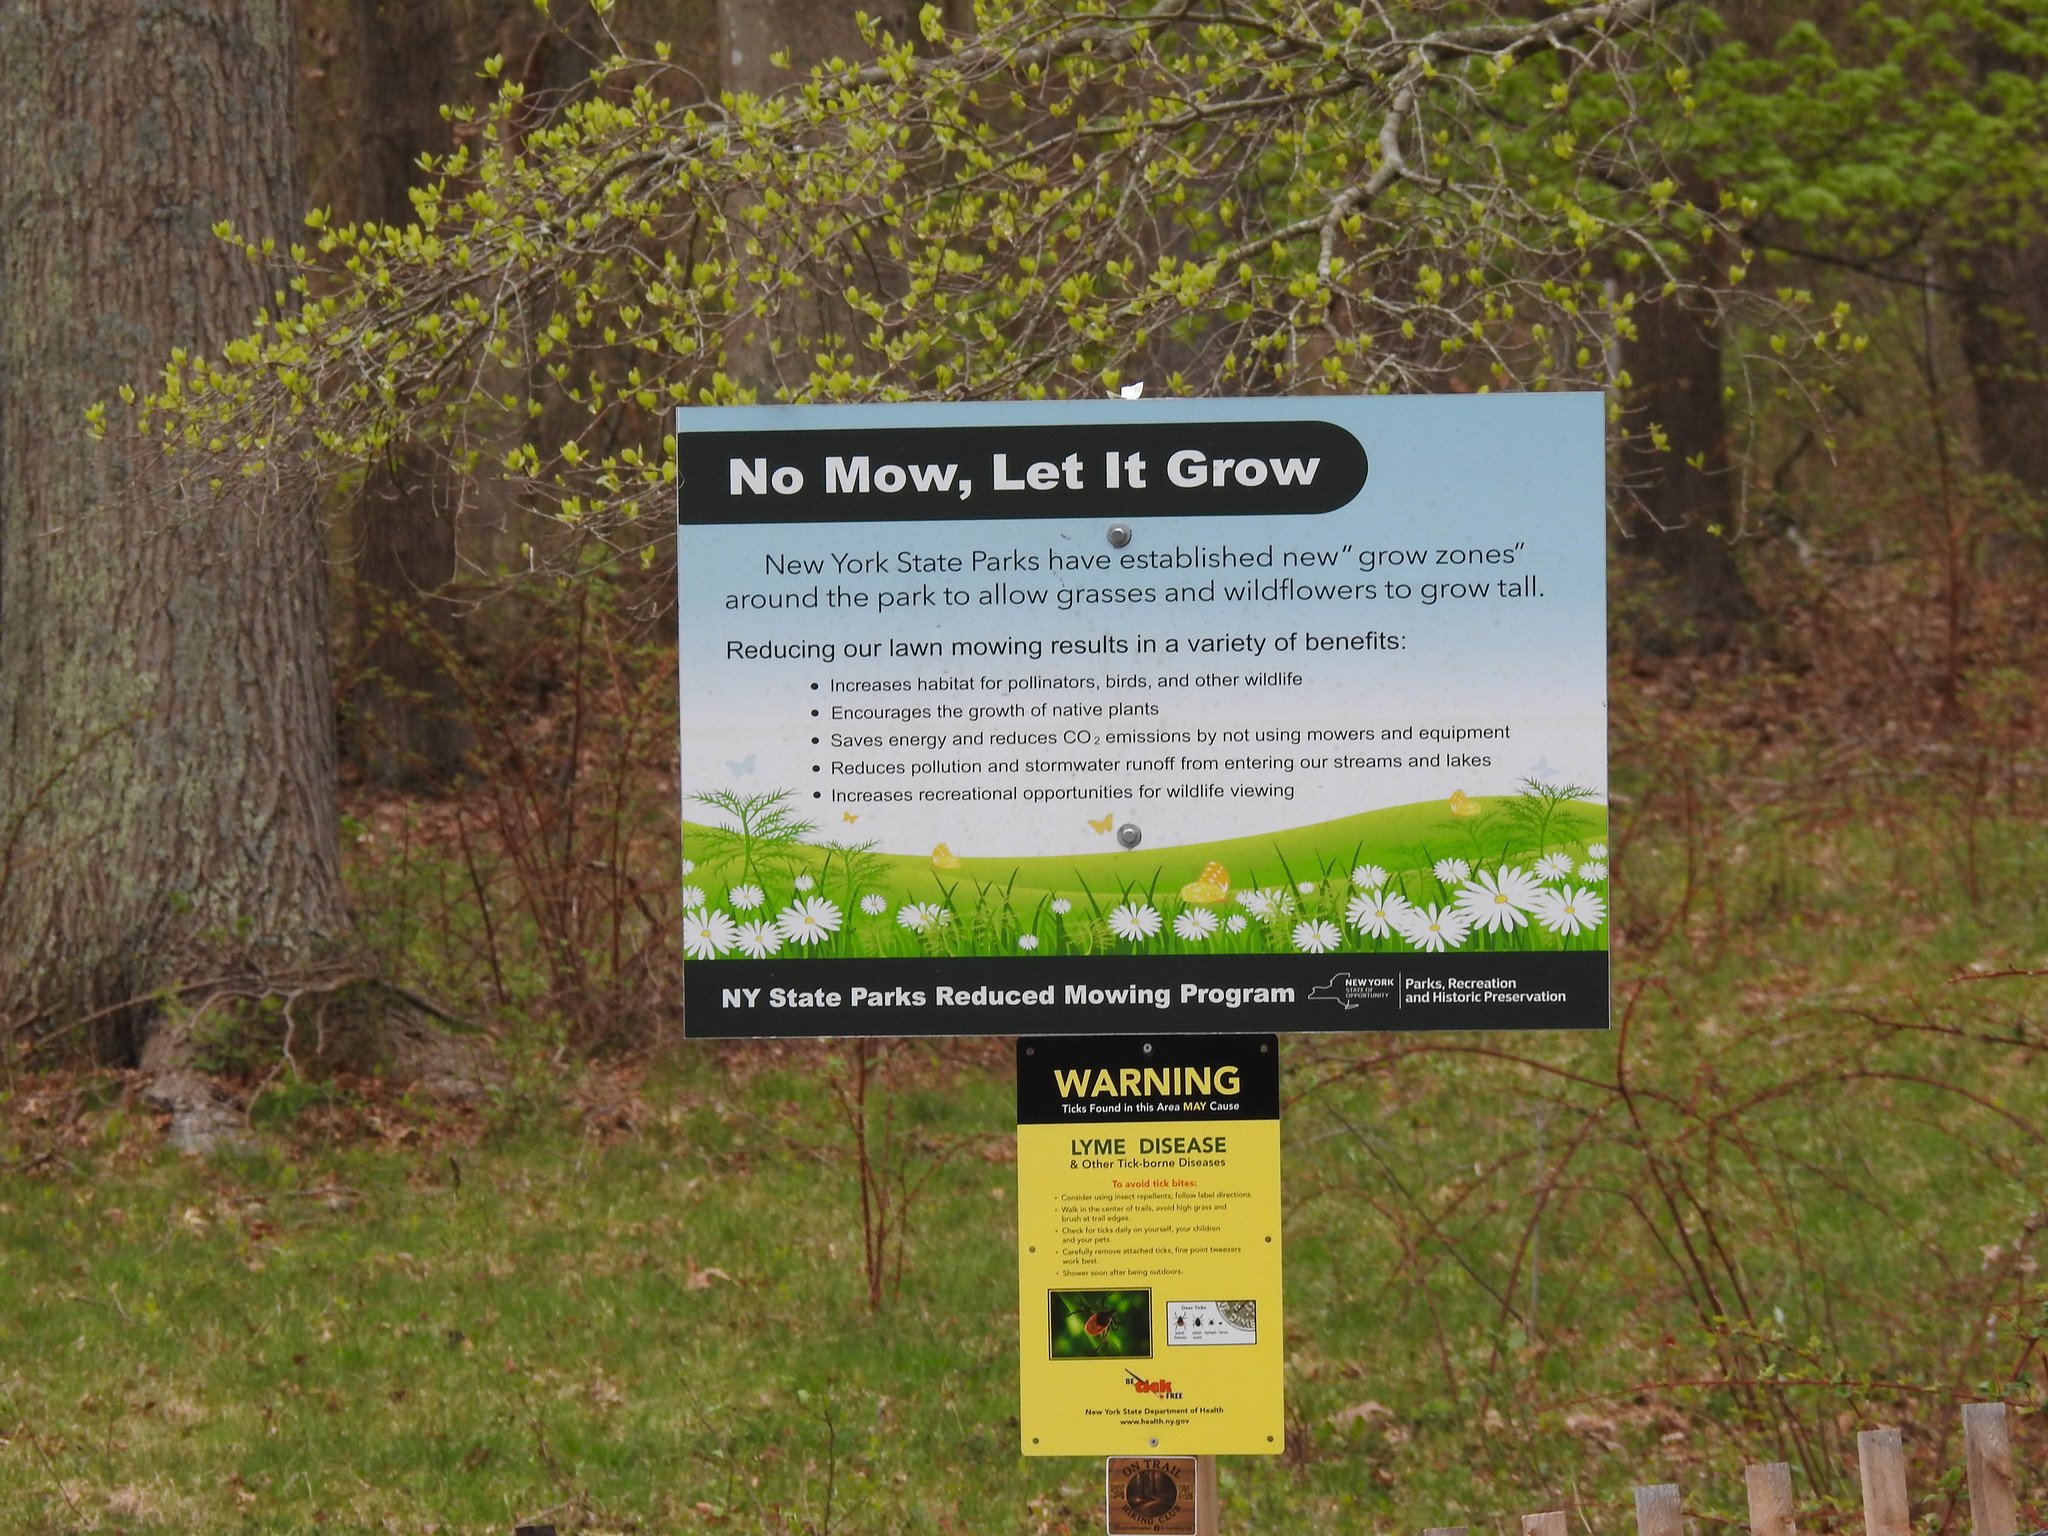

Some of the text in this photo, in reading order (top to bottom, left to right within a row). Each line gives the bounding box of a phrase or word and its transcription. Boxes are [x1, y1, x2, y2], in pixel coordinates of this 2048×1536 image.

[730, 449, 1320, 501] No Mow, Let It Grow
[765, 553, 824, 575] New
[831, 550, 888, 574] York
[897, 551, 962, 573] State
[972, 548, 1039, 571] Parks
[1049, 549, 1110, 571] have
[1119, 545, 1272, 571] established
[1359, 550, 1428, 572] grow
[725, 574, 1544, 613] around the park to allow grasses and wildflowers to grow tall.
[727, 631, 1405, 663] Reducing our lawn mowing results in a variety of benefits:
[830, 671, 1302, 692] Increases habitat for pollinators, birds, and other wildlife
[832, 702, 1159, 722] Encourages the growth of native plants
[831, 733, 882, 747] Saves
[888, 735, 946, 749] energy
[952, 731, 983, 745] and
[990, 731, 1057, 745] reduces
[1105, 729, 1190, 743] emissions
[1197, 728, 1217, 745] by
[1223, 729, 1249, 742] not
[1255, 727, 1300, 744] using
[1307, 729, 1374, 741] mowers
[1381, 726, 1412, 740] and
[1419, 725, 1510, 742] equipment
[831, 753, 1491, 777] Reduces pollution and stormwater runoff from entering our streams and lakes
[832, 783, 1294, 803] Increases recreational opportunities for wildlife viewing
[1345, 978, 1394, 987] NEW YORK
[1405, 978, 1517, 991] Parks, Recreation
[722, 983, 1294, 1009] NY State Parks Reduced Mowing Program
[1405, 990, 1566, 1003] and Historic Preservation
[1054, 1065, 1240, 1098] WARNING
[1061, 1101, 1239, 1113] Ticks Found in this Area MAY Cause
[1071, 1136, 1226, 1156] LYME DISEASE
[1070, 1157, 1225, 1169] & Other Tick-borne Diseases
[1112, 1178, 1196, 1188] To avoid tick bites:
[1122, 1407, 1142, 1415] State
[1144, 1407, 1188, 1416] Department
[1189, 1406, 1198, 1414] of
[1199, 1406, 1224, 1414] Health
[1119, 1417, 1189, 1426] www.health.ny.gov
[1123, 1459, 1181, 1479] ON TRAIL
[1121, 1504, 1181, 1525] HIKING CLUB
